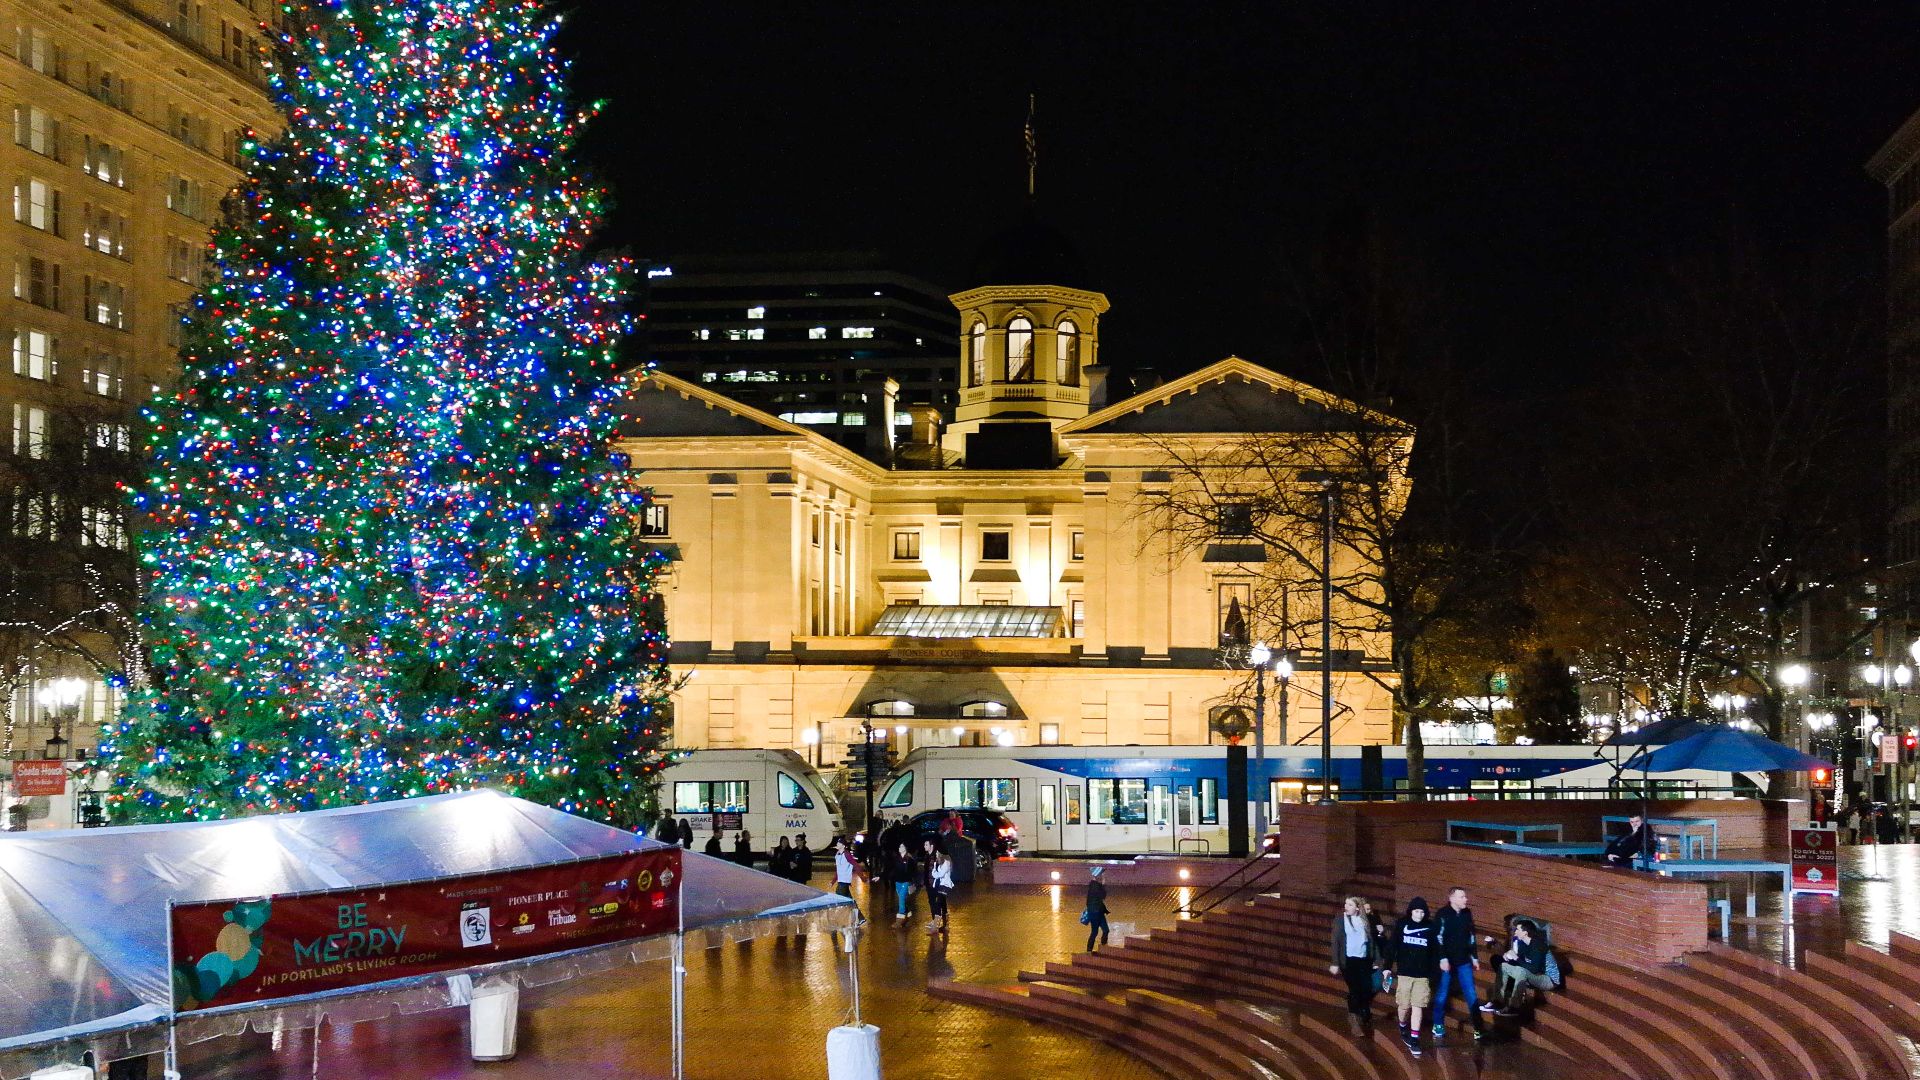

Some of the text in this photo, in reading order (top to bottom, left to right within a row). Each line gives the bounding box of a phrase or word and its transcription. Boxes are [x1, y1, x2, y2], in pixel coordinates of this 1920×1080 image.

[785, 819, 807, 828] MAX
[508, 889, 569, 907] PIONEER PLACE
[338, 902, 369, 930] BE
[549, 913, 577, 926] Tribune
[293, 925, 408, 966] MERRY
[1402, 935, 1428, 947] NIKE
[262, 952, 438, 986] IN PORTLAND'S LIVING ROOM
